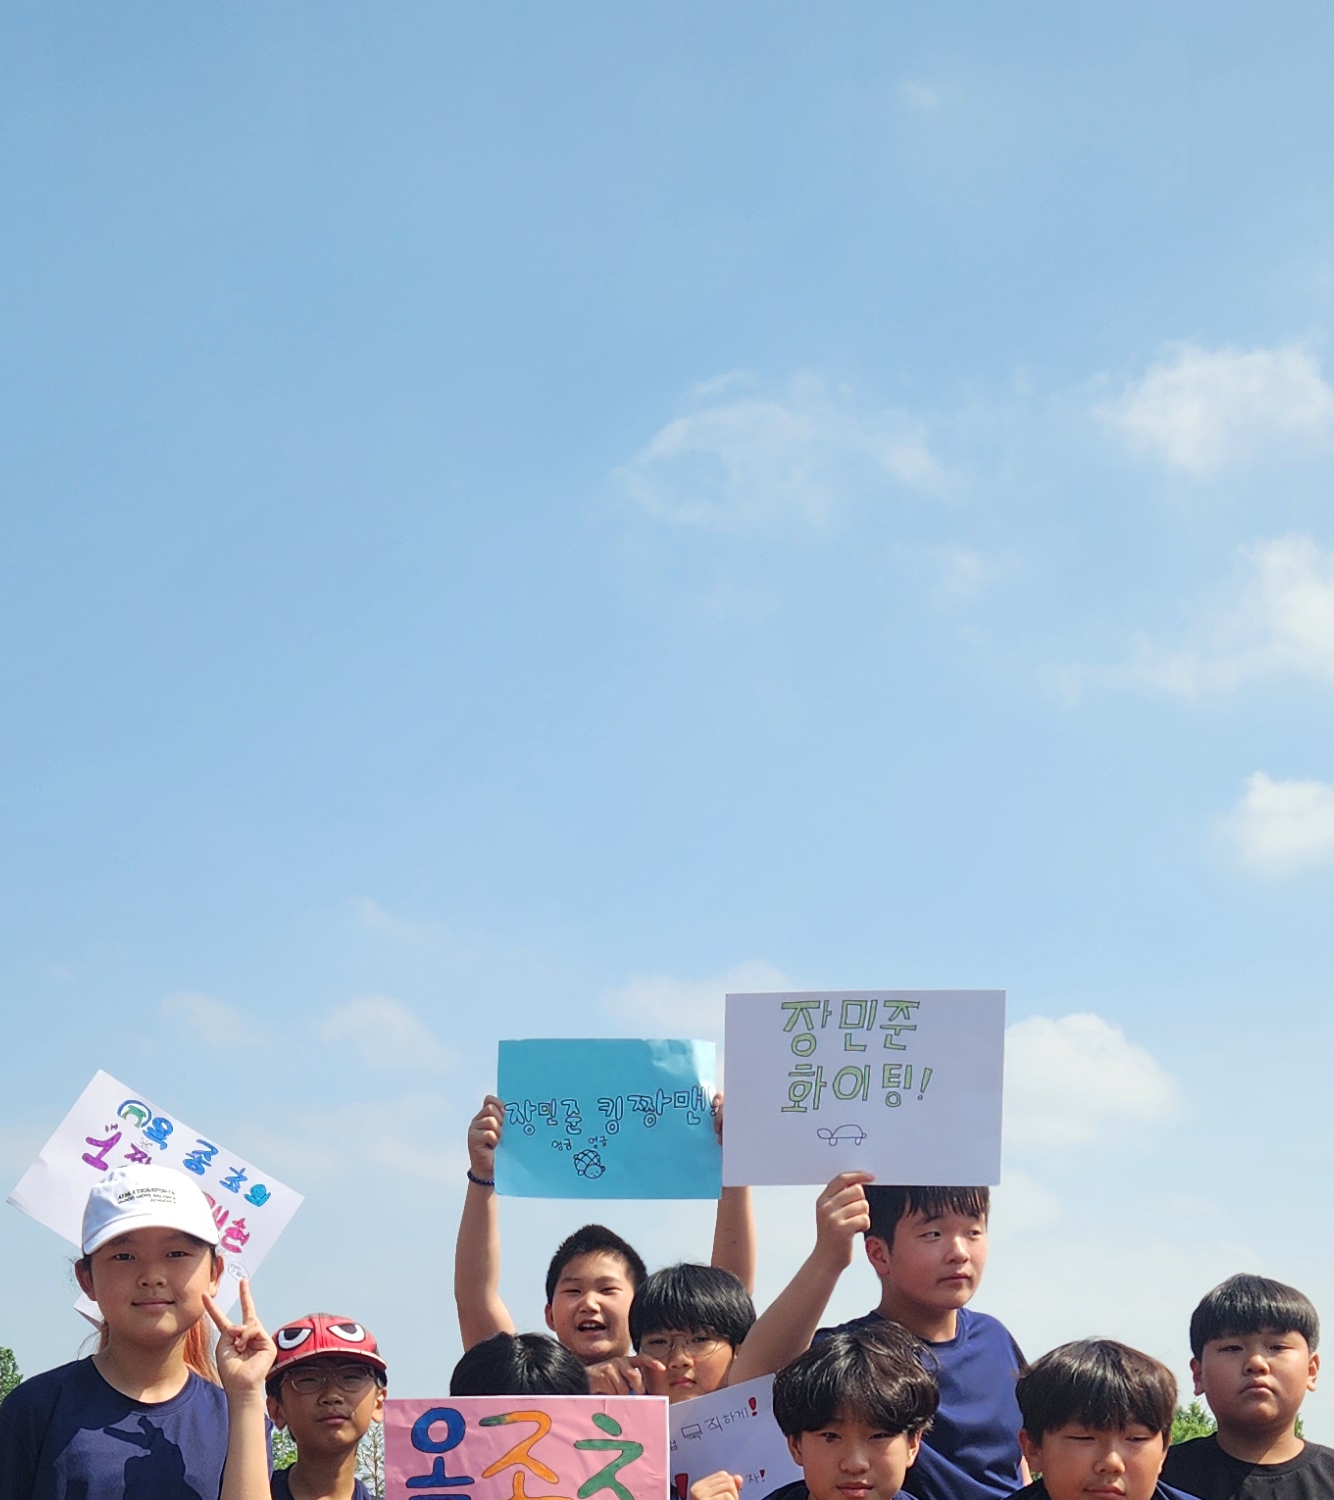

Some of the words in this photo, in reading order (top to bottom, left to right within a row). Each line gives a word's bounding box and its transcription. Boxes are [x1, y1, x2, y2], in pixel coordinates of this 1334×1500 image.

[780, 1000, 921, 1057] 장민준
[780, 1063, 933, 1113] 화이팅!
[503, 1098, 582, 1136] 장민준
